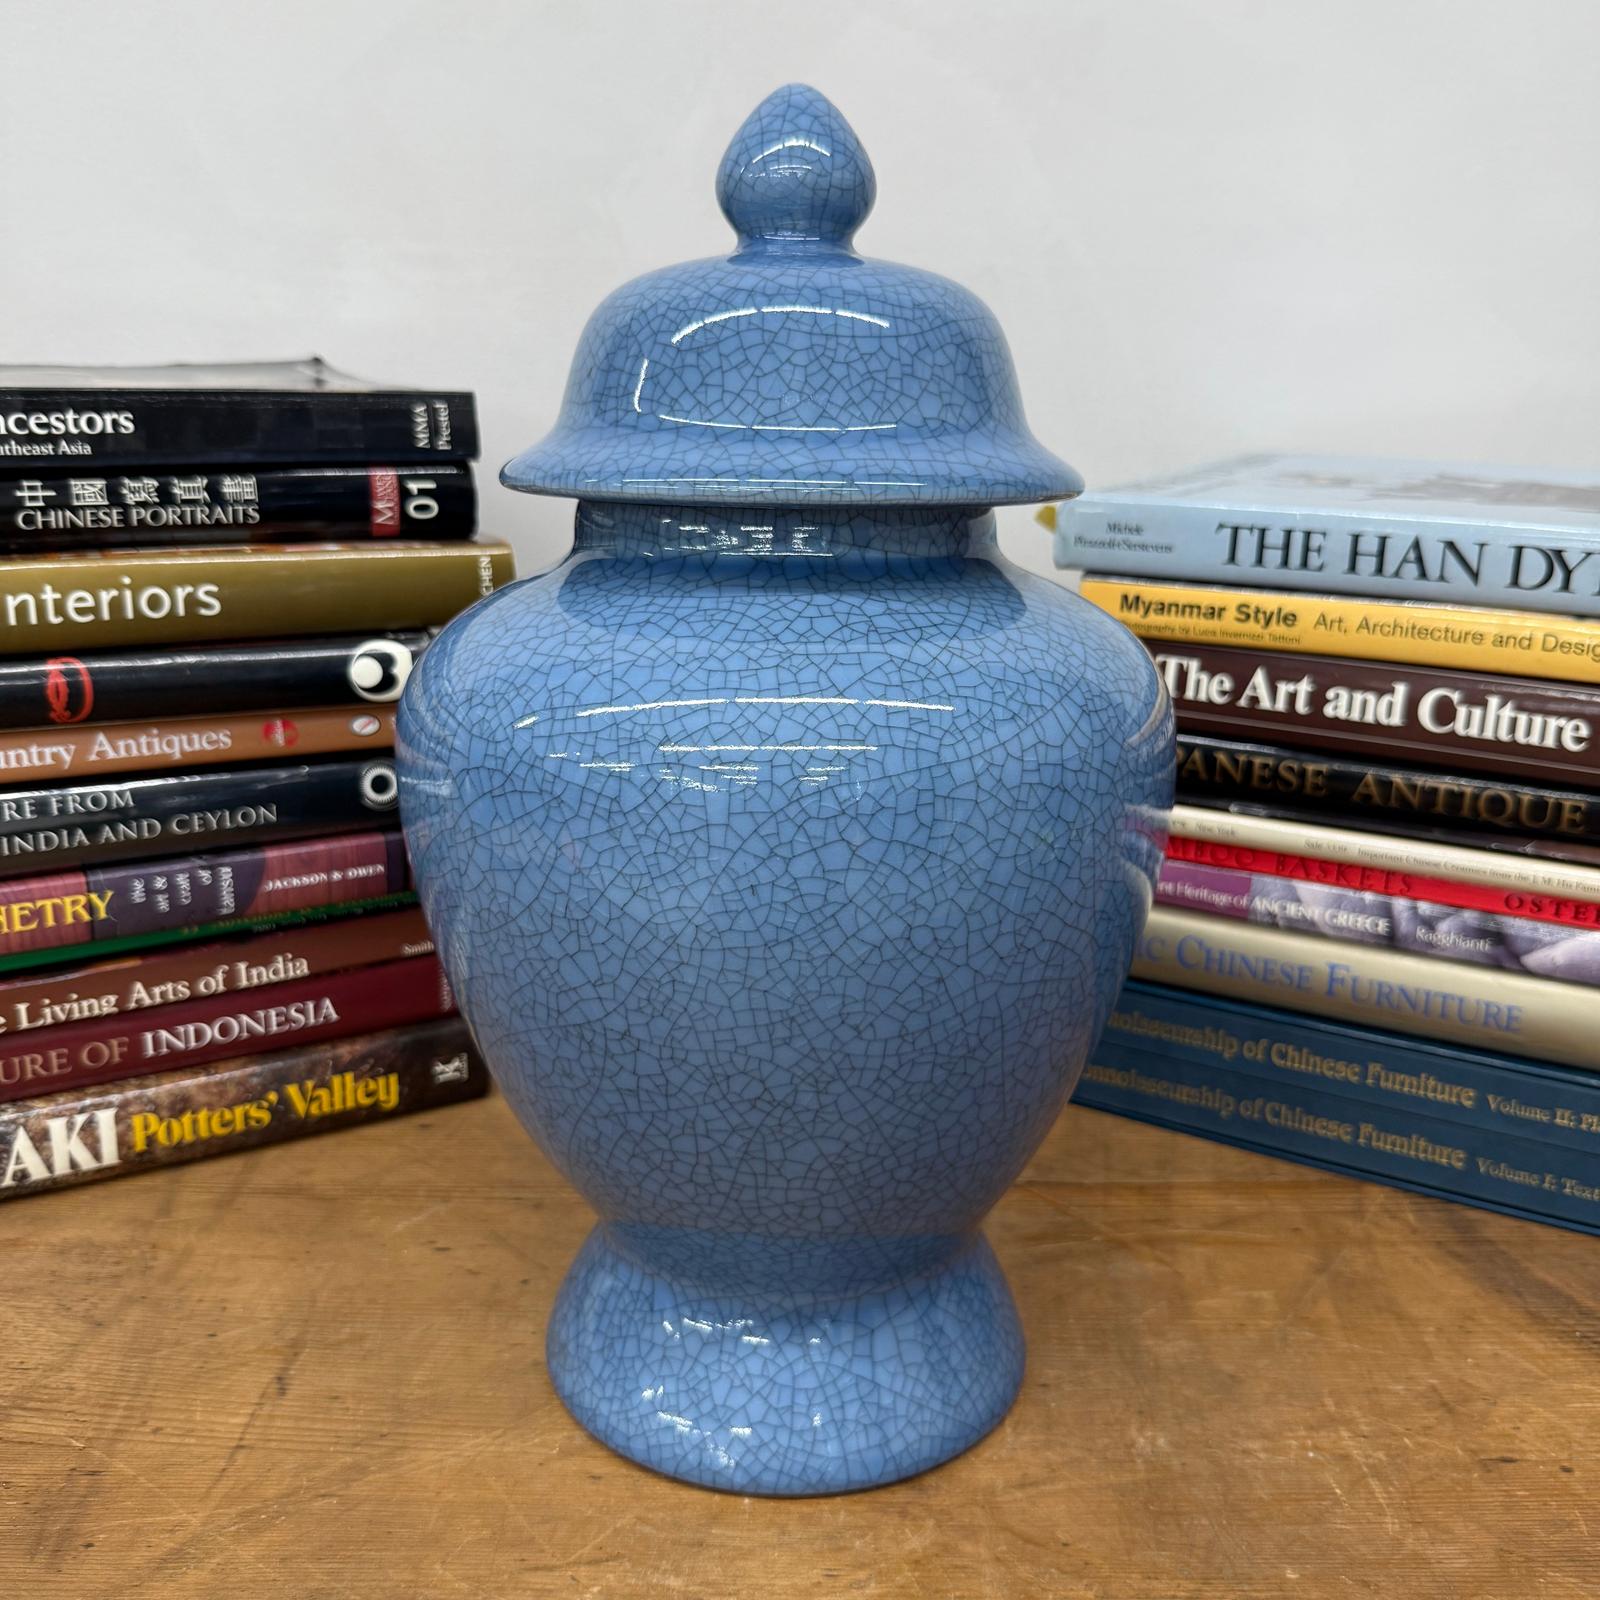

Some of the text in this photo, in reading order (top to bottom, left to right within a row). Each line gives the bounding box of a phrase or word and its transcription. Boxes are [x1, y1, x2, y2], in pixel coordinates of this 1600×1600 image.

[58, 439, 93, 456] Asia
[16, 502, 261, 531] CHINESE PORTRAITS
[404, 479, 439, 520] 01
[1215, 521, 1327, 573] THE
[1344, 534, 1492, 588] HAN
[6, 575, 223, 627] nteriors
[1119, 593, 1227, 619] Myanmar
[1234, 602, 1298, 630] Style
[1313, 611, 1349, 635] Art,
[1355, 616, 1485, 646] Architecture
[1490, 631, 1534, 651] and
[1155, 653, 1593, 752] The Art and Culture
[88, 727, 233, 761] Antiques
[0, 803, 278, 857] INDIA AND CEYLON
[50, 789, 136, 817] FROM
[1352, 770, 1587, 834] ANTIQUE
[264, 863, 386, 893] JACKSON & OWEN
[1250, 896, 1321, 921] ANCIENT
[1323, 908, 1392, 936] GREECE
[15, 993, 119, 1031] Living
[127, 980, 191, 1011] Arts
[197, 964, 229, 996] of
[234, 953, 311, 989] India
[0, 996, 342, 1085] URE OF INDONESIA
[1243, 1037, 1269, 1062] of
[1270, 1042, 1361, 1084] Chinese
[1365, 1061, 1478, 1109] Furniture
[1486, 1093, 1552, 1124] Volume
[0, 1106, 122, 1188] AKI
[285, 1070, 400, 1119] Valley
[1238, 1097, 1265, 1119] of
[1265, 1101, 1354, 1144] Chinese
[1357, 1121, 1468, 1171] Furniture
[1475, 1157, 1541, 1188] Volume
